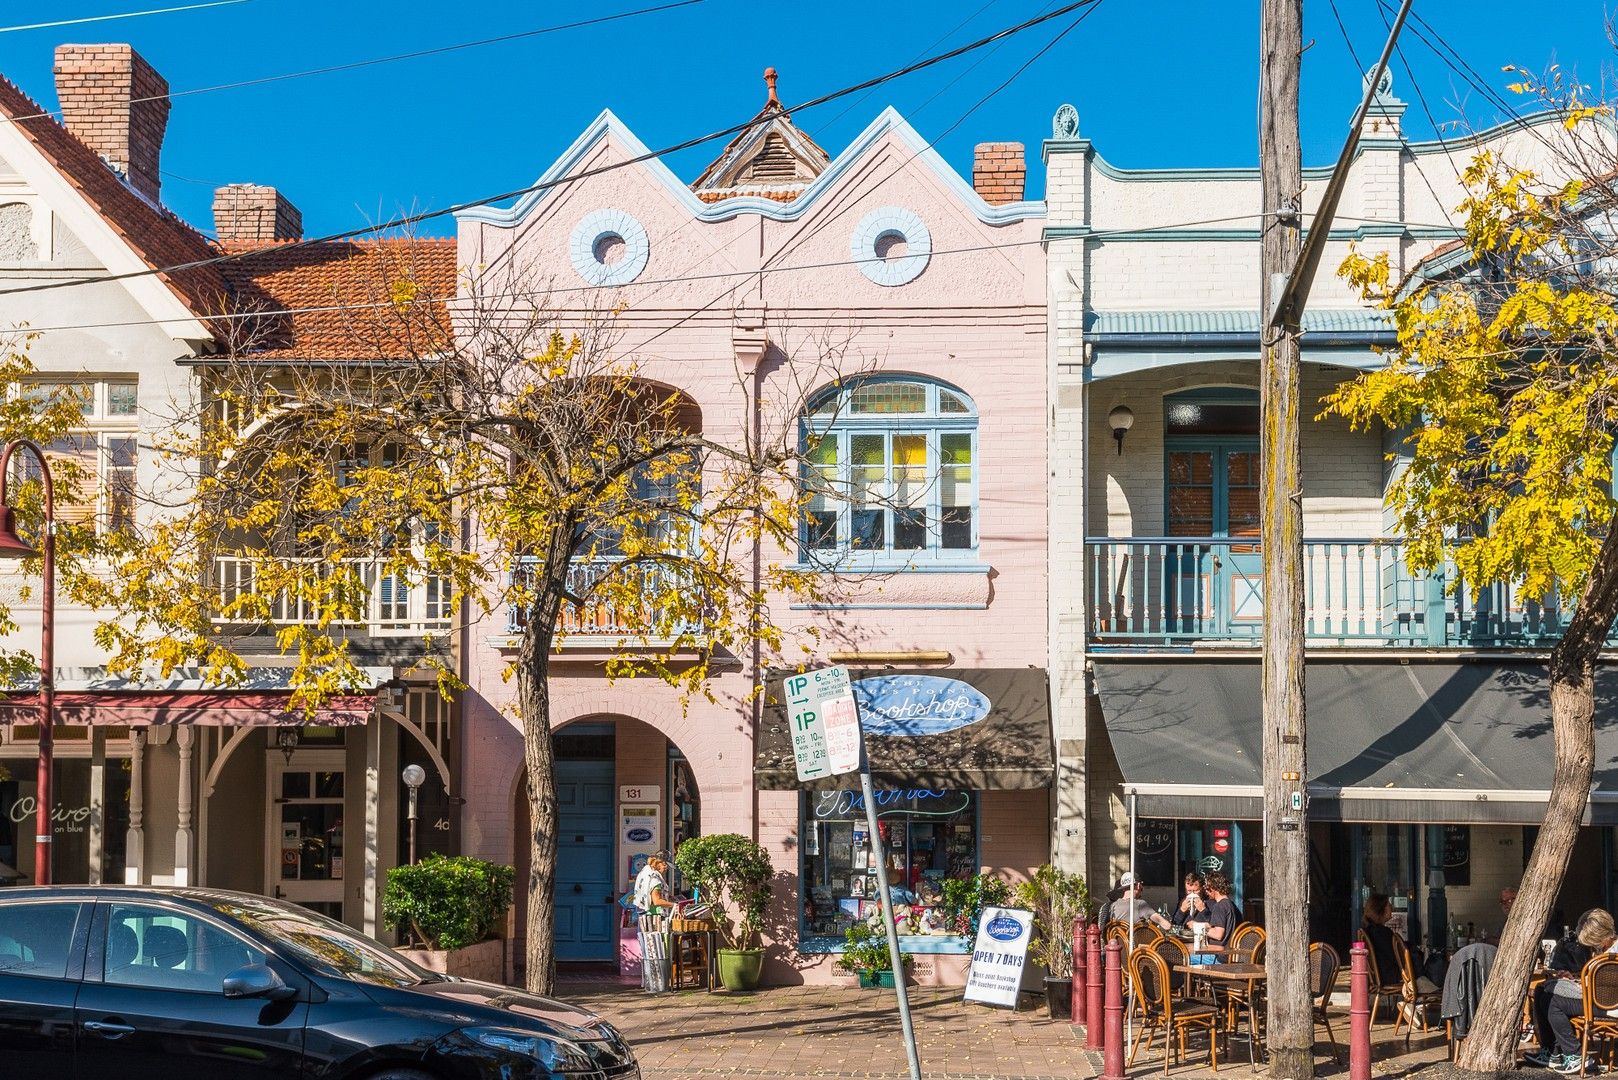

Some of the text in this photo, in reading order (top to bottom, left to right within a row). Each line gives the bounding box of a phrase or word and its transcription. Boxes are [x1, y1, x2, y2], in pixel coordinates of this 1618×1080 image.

[788, 677, 808, 696] 1P
[858, 694, 980, 722] Bookshop
[795, 712, 817, 731] 1P
[626, 789, 641, 798] 131
[1293, 795, 1301, 806] H
[10, 796, 92, 823] Oivo
[67, 821, 84, 833] blue
[974, 950, 1023, 967] OPEN 7 DAYS
